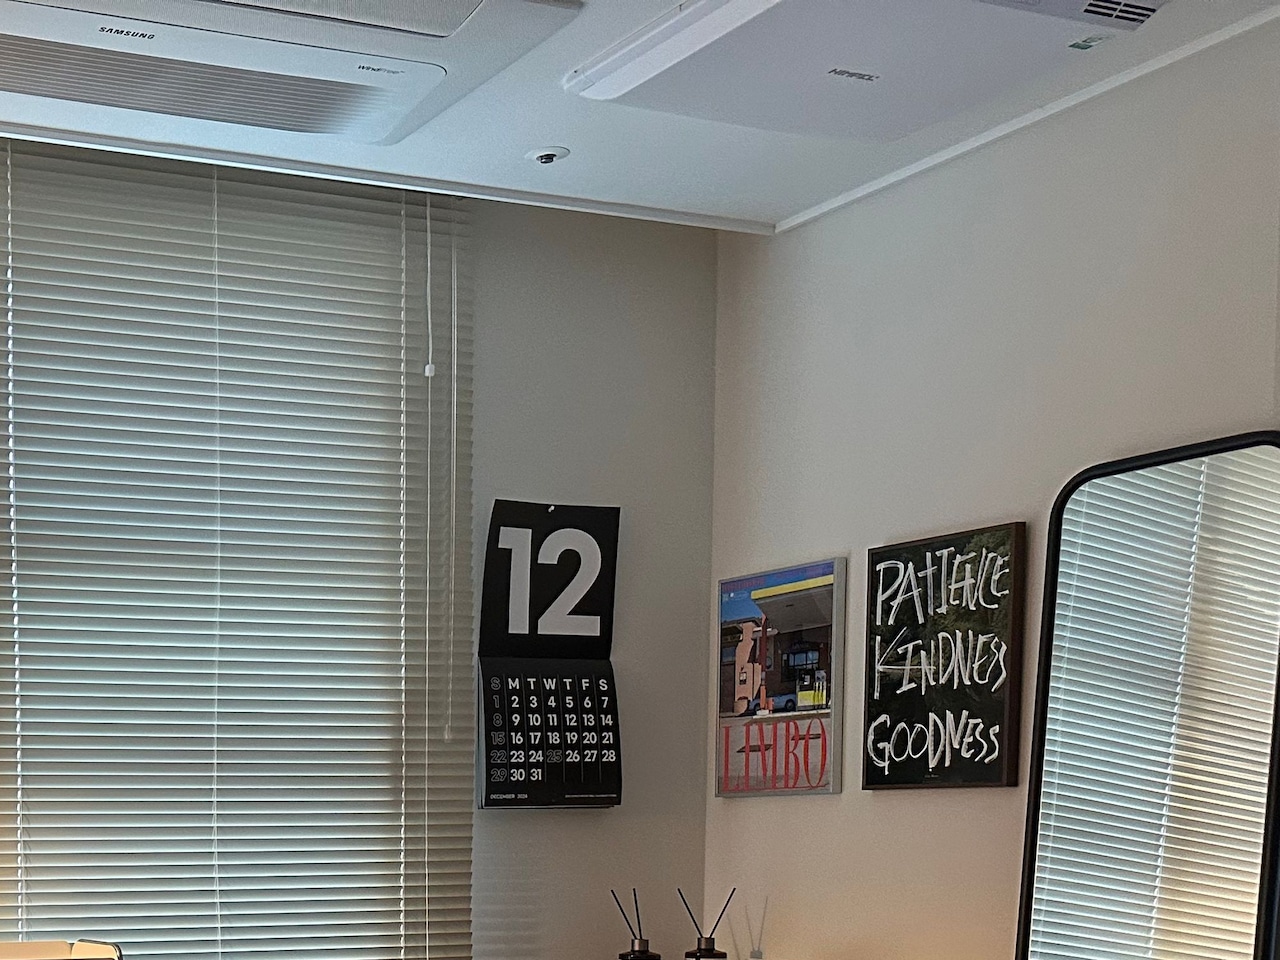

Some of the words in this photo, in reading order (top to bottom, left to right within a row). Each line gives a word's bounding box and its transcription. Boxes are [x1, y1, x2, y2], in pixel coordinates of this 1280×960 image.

[99, 26, 155, 40] SAMSUNG
[498, 526, 602, 636] 12
[876, 547, 1011, 626] PATIENCE
[873, 626, 1008, 700] KINDNESS
[491, 677, 500, 690] S
[508, 678, 519, 689] M
[527, 678, 536, 690] T
[543, 678, 556, 690] W
[563, 679, 572, 690] T
[582, 679, 589, 690] F
[599, 679, 608, 690] S
[493, 695, 500, 708] 1
[511, 696, 519, 707] 2
[530, 696, 537, 708] 3
[548, 696, 556, 708] 4
[566, 696, 573, 708] 5
[584, 696, 591, 708] 6
[601, 697, 608, 708] 7
[493, 713, 502, 727] 8
[512, 714, 520, 726] 9
[528, 714, 541, 726] 10
[548, 714, 557, 726] 11
[565, 714, 577, 726] 12
[583, 714, 595, 726] 13
[600, 714, 613, 726] 14
[491, 732, 505, 745] 15
[511, 732, 523, 744] 16
[529, 732, 541, 744] 17
[547, 732, 560, 744] 18
[566, 732, 578, 744] 19
[583, 733, 597, 744] 20
[602, 733, 613, 744] 21
[867, 709, 1000, 775] GOODNESS
[490, 750, 507, 763] 22
[510, 751, 524, 762] 23
[529, 751, 543, 762] 24
[566, 750, 580, 762] 26
[584, 750, 597, 762] 27
[602, 750, 616, 762] 28
[722, 717, 828, 792] LIMBO
[490, 768, 507, 781] 29
[510, 769, 525, 780] 30
[530, 769, 542, 780] 31
